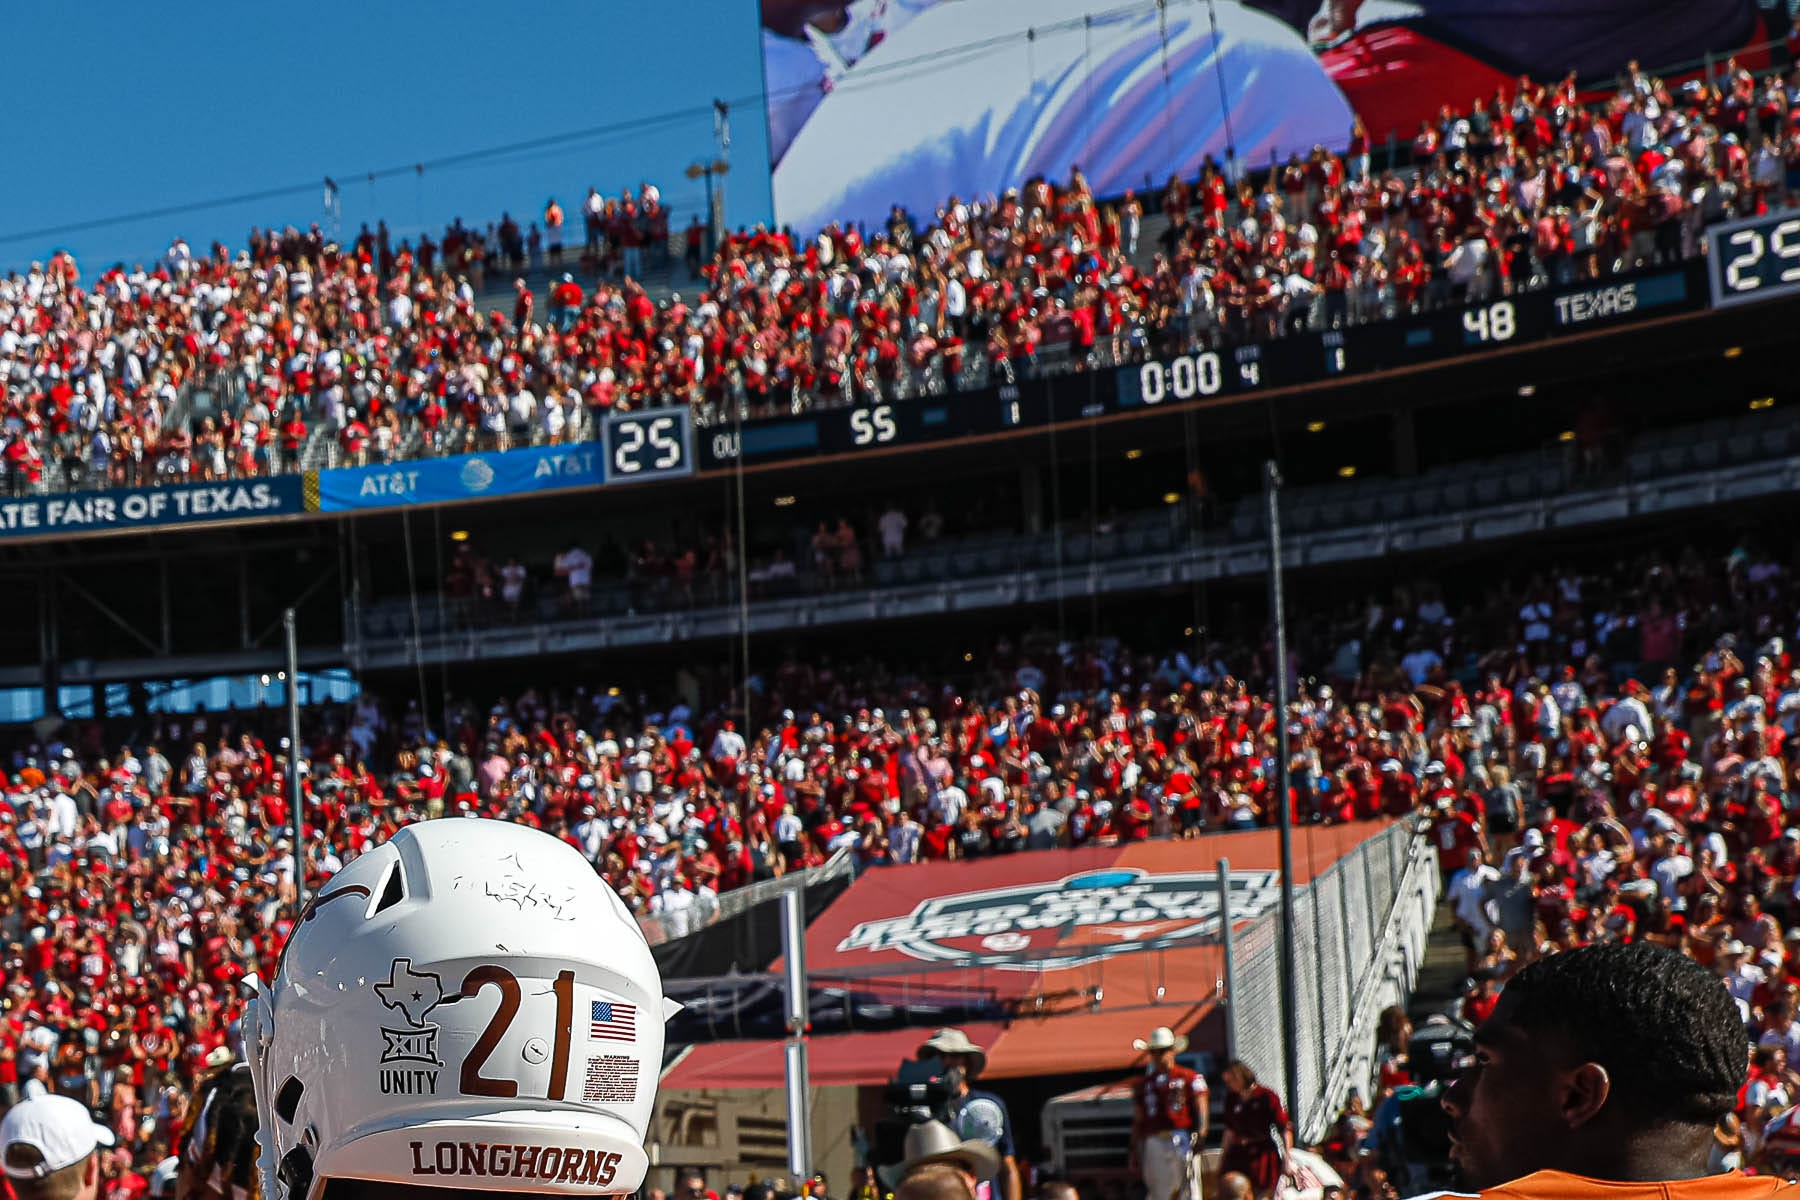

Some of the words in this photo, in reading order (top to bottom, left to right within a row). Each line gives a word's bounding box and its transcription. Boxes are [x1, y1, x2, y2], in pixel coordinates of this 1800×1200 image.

[1462, 301, 1516, 343] 48
[1554, 281, 1638, 325] TEXAS
[1140, 352, 1222, 404] 0:00
[1240, 361, 1260, 385] 4
[615, 416, 683, 474] 25
[712, 432, 741, 460] OU
[850, 405, 897, 446] 55
[360, 470, 419, 497] AT&T
[534, 453, 593, 479] AT&T
[46, 491, 116, 526] FAIR
[122, 488, 167, 519] OF
[170, 483, 281, 517] TEXAS.
[459, 965, 575, 1101] 21
[380, 1070, 439, 1095] UNITY
[409, 1141, 623, 1187] LONGHORNS
